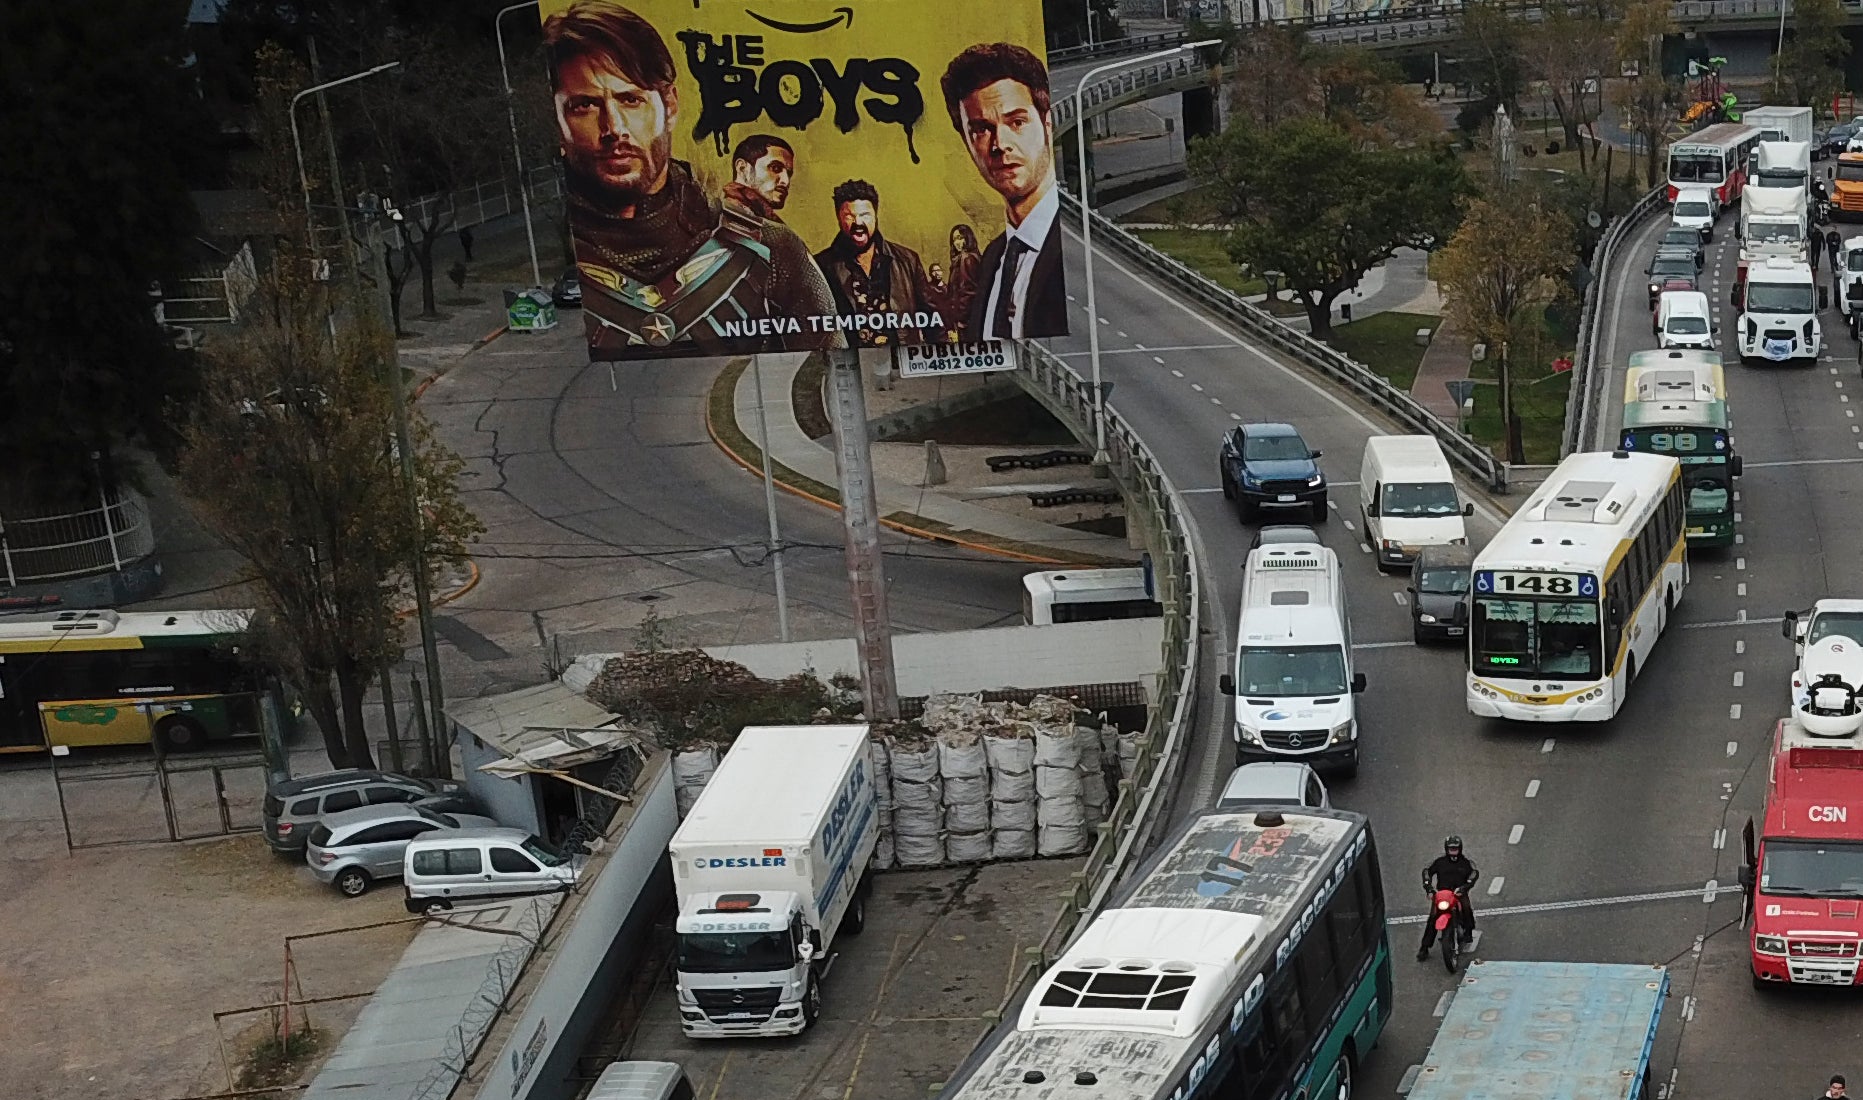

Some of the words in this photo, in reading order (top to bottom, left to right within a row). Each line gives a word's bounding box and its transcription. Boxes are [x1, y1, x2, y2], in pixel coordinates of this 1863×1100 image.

[676, 29, 764, 72] THE
[692, 58, 924, 160] BOYS
[725, 318, 801, 337] NUEVA
[807, 311, 944, 332] TEMPORADA
[928, 358, 961, 371] 4812
[964, 354, 1005, 368] 0600
[1651, 433, 1697, 451] 98
[1499, 575, 1573, 594] 148
[1808, 805, 1847, 822] C5N
[709, 858, 786, 868] DESLER
[703, 923, 771, 931] DESLER
